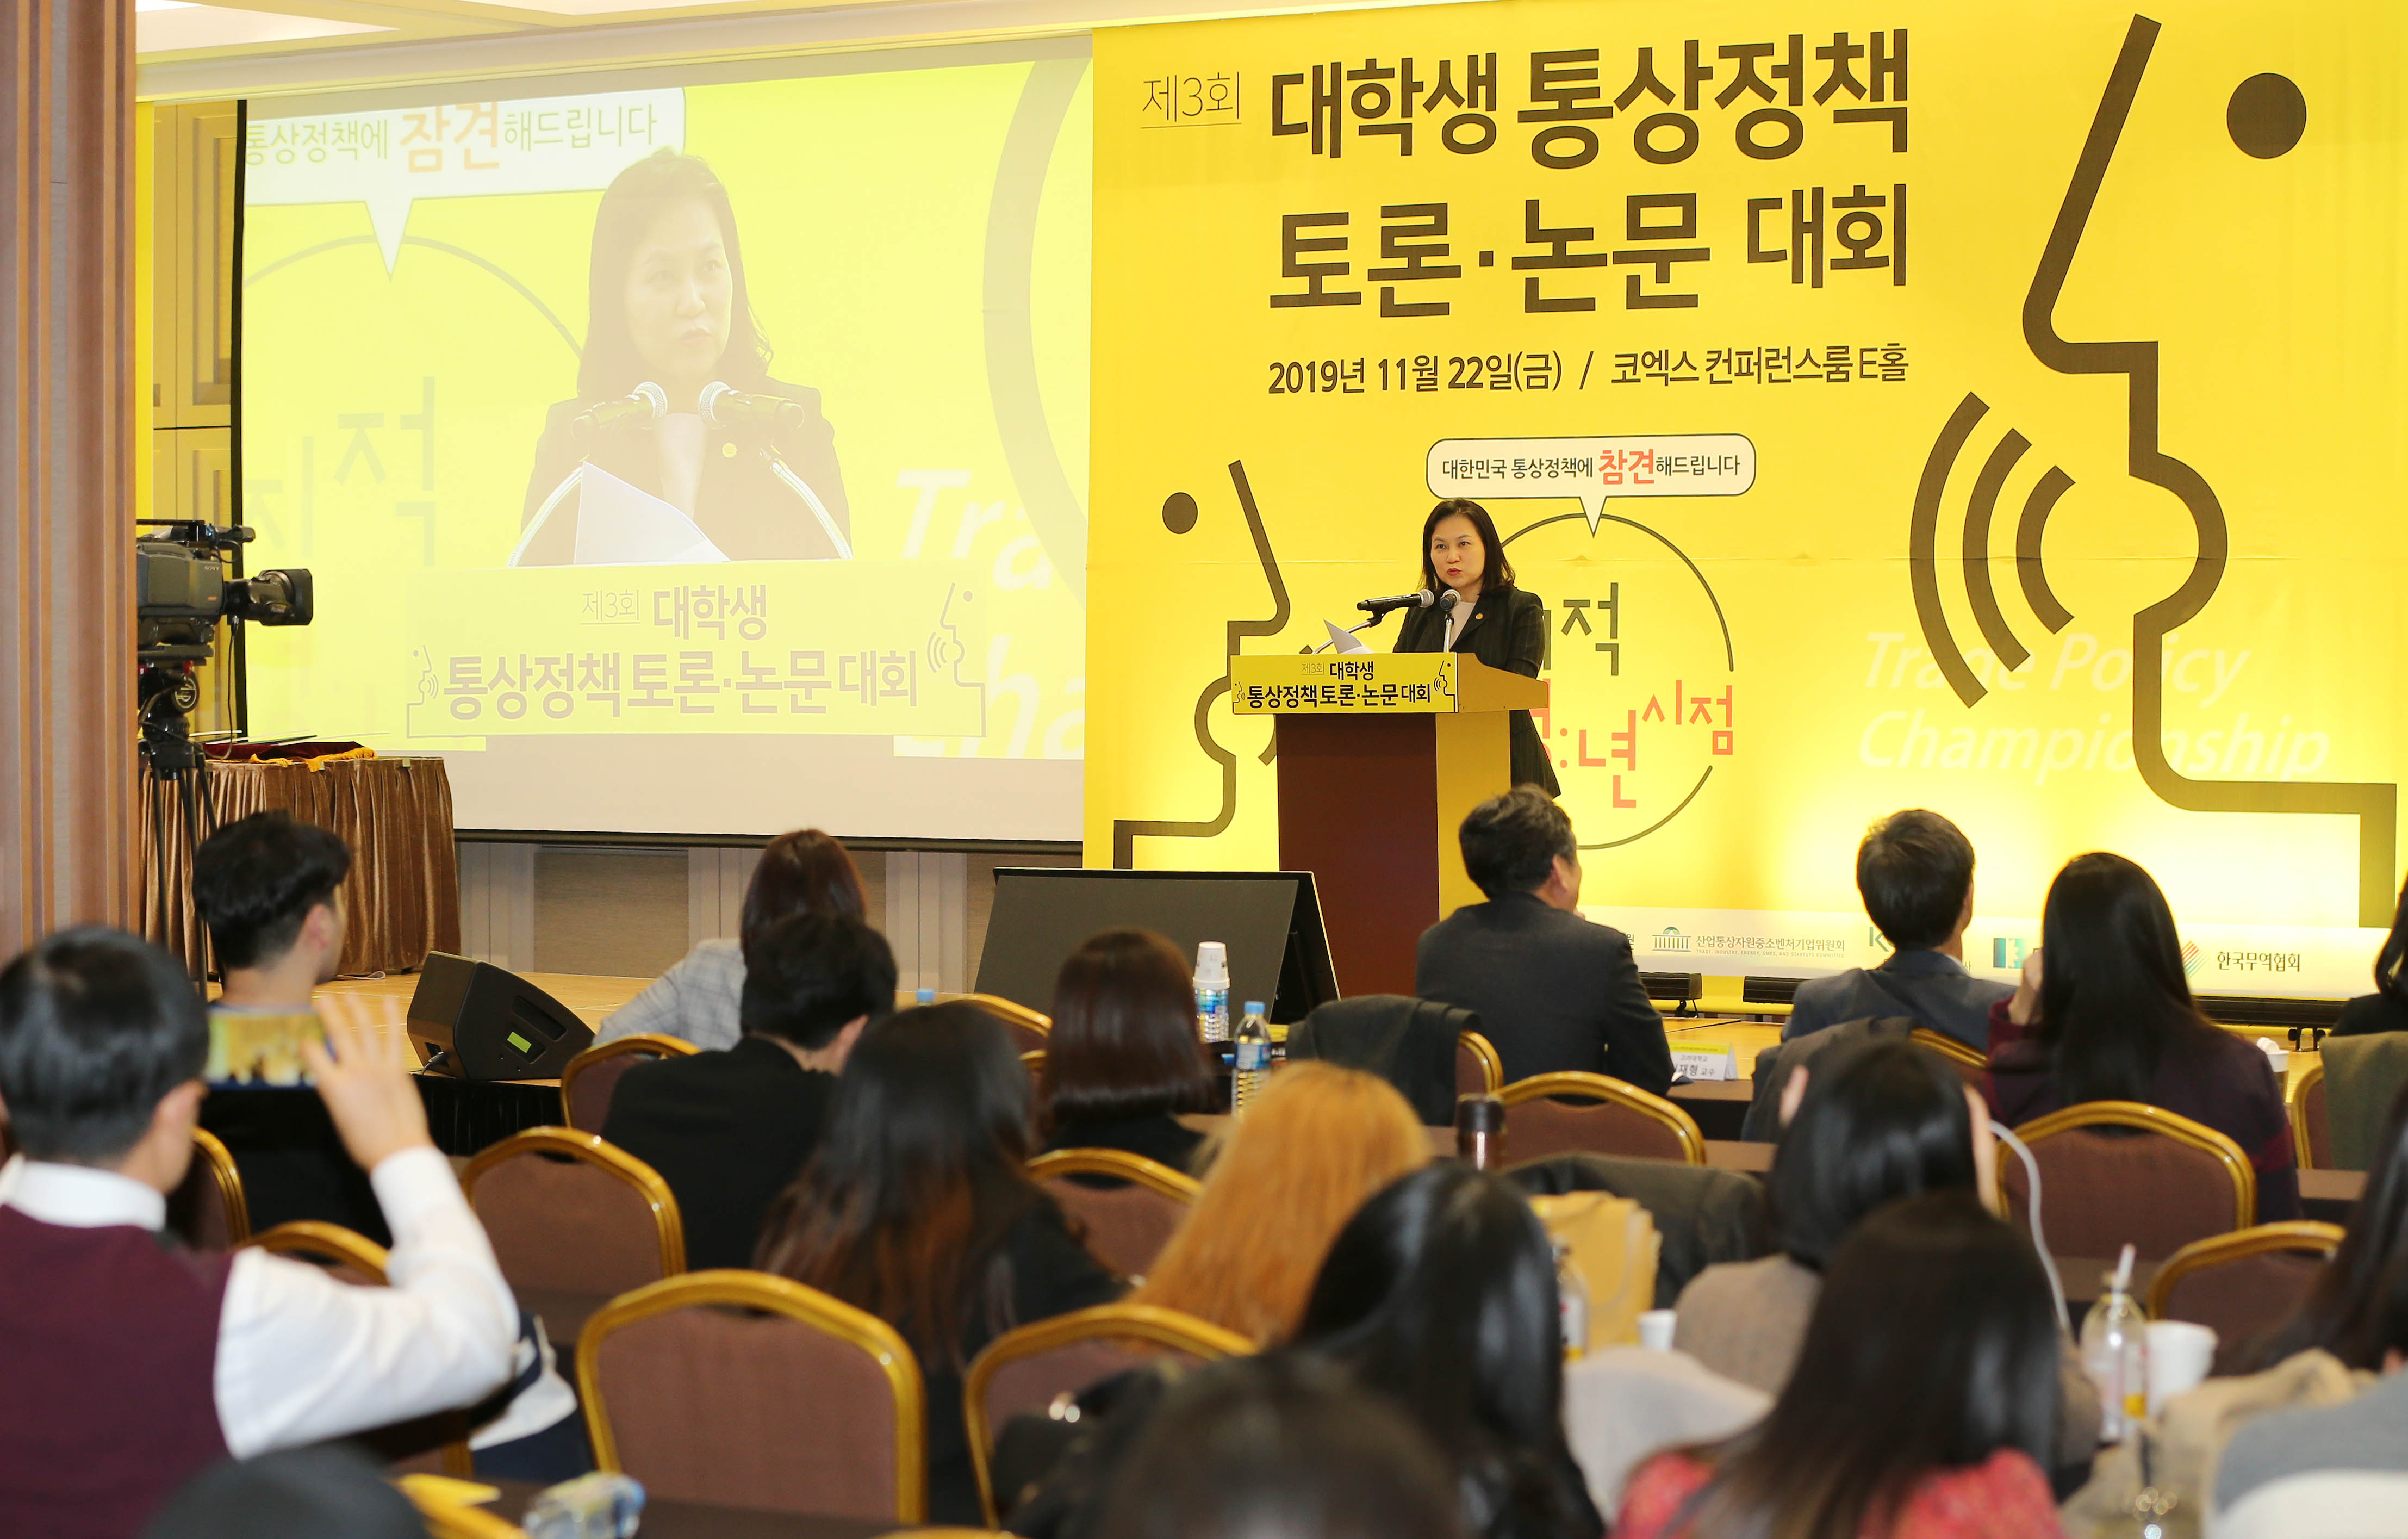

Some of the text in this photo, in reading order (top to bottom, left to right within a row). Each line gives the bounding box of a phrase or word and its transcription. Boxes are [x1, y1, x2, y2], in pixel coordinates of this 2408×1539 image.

[1142, 28, 1908, 170] 제3회 대학생 통상정책
[1270, 183, 1907, 318] 토론·논문 대회
[1268, 357, 1365, 394] 2019년
[1378, 355, 1439, 393] 11월
[1447, 350, 1562, 392] 22일(금)
[1611, 349, 1700, 387] 코엑스
[1704, 345, 1853, 385] 컨퍼런스룸
[1858, 343, 1909, 382] E홀
[1442, 459, 1508, 480] 대한민국
[1510, 457, 1593, 479] 통상정책에
[581, 584, 767, 641] 제3회 대학생
[443, 651, 620, 721] 통상정책
[838, 650, 917, 708] 대회
[1247, 685, 1317, 708] 통상정책
[1401, 684, 1430, 703] 대회
[1302, 661, 1374, 681] 제3회 대학생
[2049, 631, 2252, 710] Poicy
[1641, 679, 1733, 755] 시점
[2217, 951, 2300, 972] 한국무역협회
